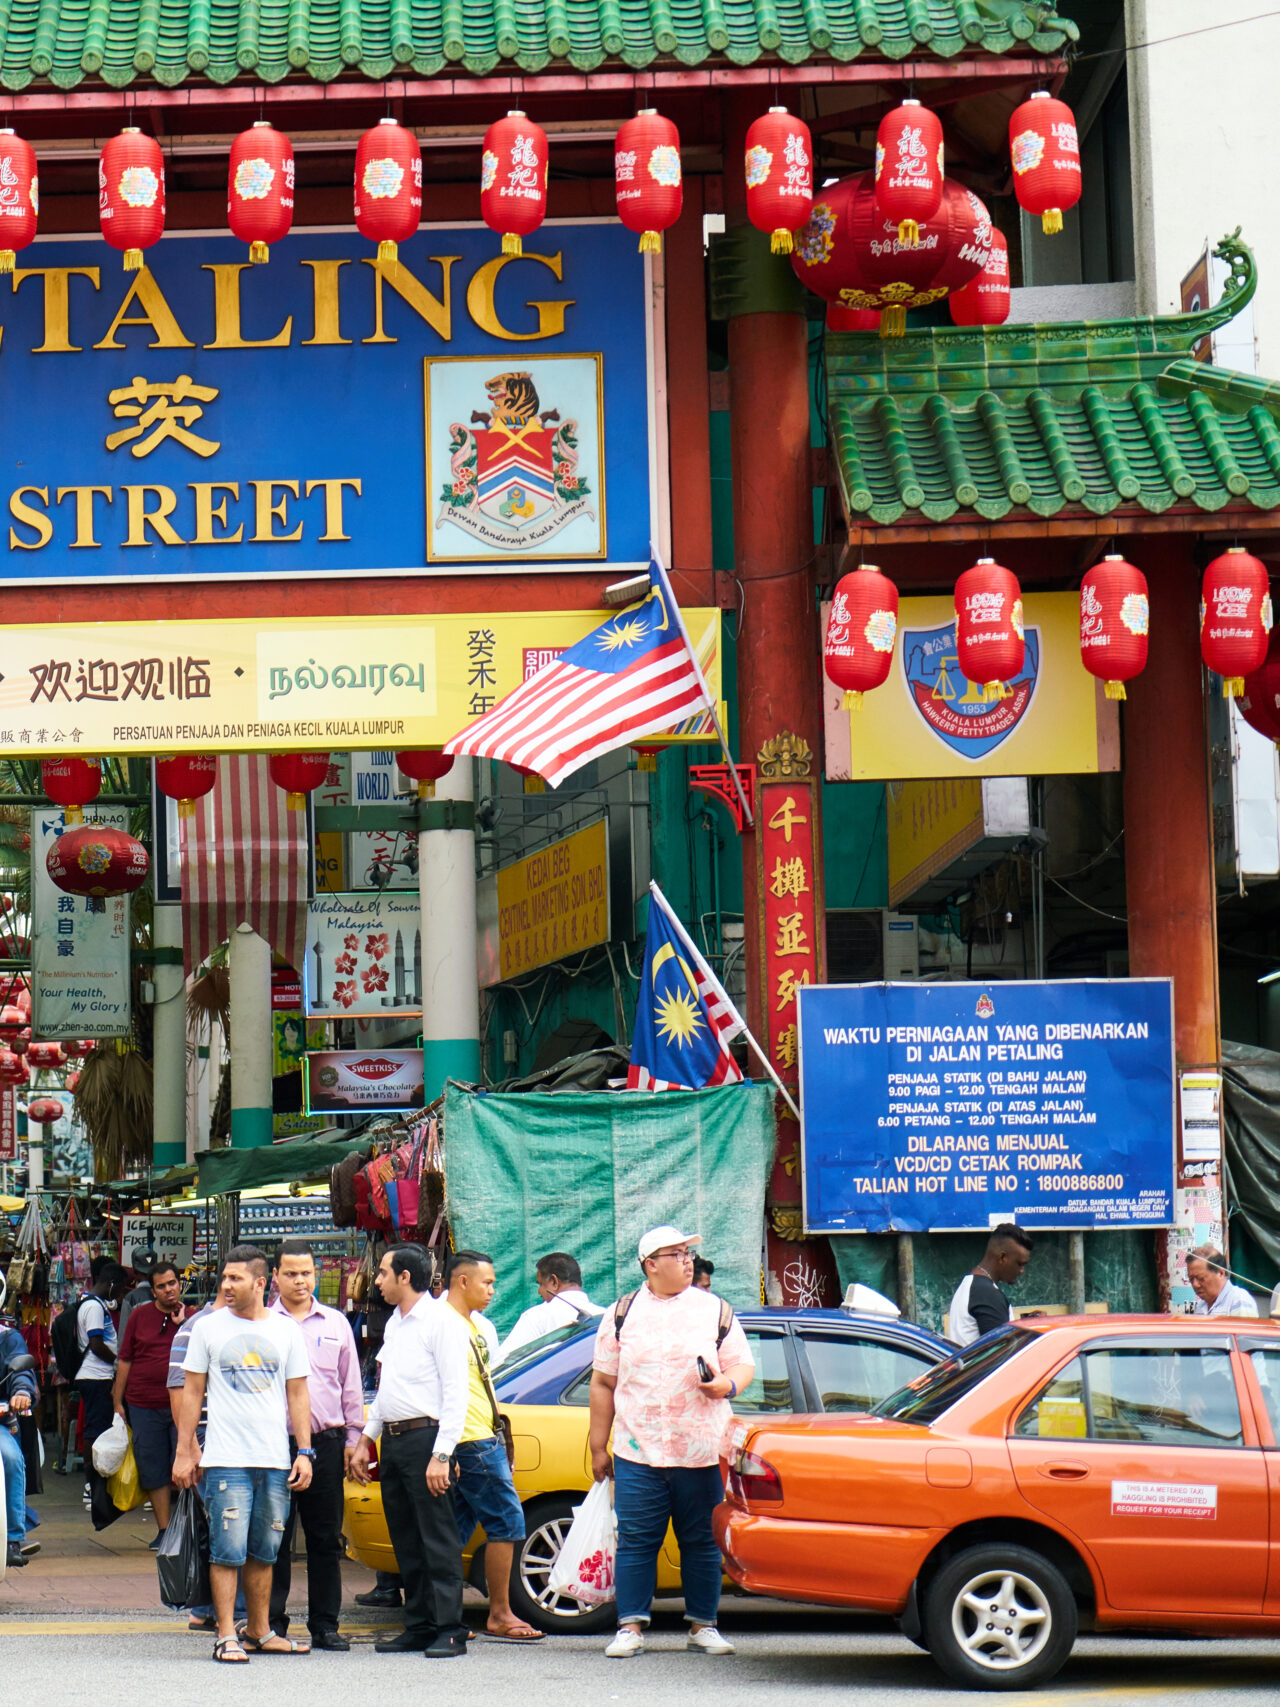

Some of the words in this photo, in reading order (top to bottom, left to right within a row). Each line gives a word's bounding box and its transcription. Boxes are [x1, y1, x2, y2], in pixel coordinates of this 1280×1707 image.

[8, 478, 364, 549] STREET
[447, 507, 477, 529] Dewan
[479, 526, 527, 545] Bandaraya
[529, 525, 554, 540] Kuala
[554, 501, 586, 525] Lumpur
[29, 656, 211, 703] 欢迎观临
[962, 705, 987, 714] 1953
[942, 708, 970, 726] KUALA
[973, 707, 1008, 727] LUMPUR
[113, 726, 173, 741] PERSATUAN
[175, 724, 221, 740] PENJAJA
[223, 724, 244, 738] DAN
[247, 723, 291, 738] PENIAGA
[293, 722, 323, 737] KECIL
[325, 721, 361, 736] KUALA
[362, 720, 405, 735] LUMPUR
[957, 726, 983, 736] PETTY
[357, 772, 390, 801] WORLD
[310, 900, 365, 914] Wholesale
[327, 916, 384, 934] Malaysia
[39, 988, 63, 998] Your
[66, 988, 107, 1000] Health,
[71, 1002, 88, 1013] My
[90, 1002, 120, 1013] Glory
[823, 1027, 881, 1045] WAKTU
[886, 1025, 988, 1043] PERNIAGAAN
[995, 1024, 1039, 1041] YANG
[1045, 1022, 1149, 1040] DIBENARKAN
[906, 1046, 923, 1062] DI
[928, 1045, 981, 1062] JALAN
[987, 1044, 1064, 1061] PETALING
[351, 1064, 398, 1073] SWEETKISS
[887, 1072, 939, 1084] PENJAJA
[943, 1072, 982, 1083] STATIK
[986, 1071, 1003, 1084] (DI
[1007, 1071, 1040, 1083] BAHU
[1043, 1070, 1088, 1083] JALAN)
[377, 1082, 416, 1091] Chocolate
[888, 1085, 911, 1097] 9.00
[915, 1085, 941, 1097] PAGI
[957, 1084, 985, 1096] 12.00
[989, 1083, 1038, 1095] TENGAH
[1041, 1082, 1086, 1094] MALAM
[888, 1102, 939, 1114] PENJAJA
[943, 1101, 982, 1113] STATIK
[986, 1101, 1003, 1114] (DI
[1007, 1100, 1036, 1112] ATAS
[1041, 1100, 1084, 1113] JALAN)
[877, 1115, 900, 1127] 6.00
[904, 1115, 951, 1126] PETANG
[967, 1114, 995, 1126] 12.00
[1000, 1113, 1049, 1125] TENGAH
[1053, 1112, 1097, 1124] MALAM
[908, 1135, 990, 1153] DILARANG
[996, 1133, 1069, 1151] MENJUAL
[894, 1156, 952, 1173] VCD/CD
[958, 1155, 1010, 1172] CETAK
[1017, 1153, 1083, 1170] ROMPAK
[853, 1178, 909, 1194] TALIAN
[915, 1177, 947, 1193] HOT
[954, 1176, 988, 1192] LINE
[994, 1175, 1019, 1191] NO
[1036, 1174, 1124, 1190] 1800886800
[1014, 1206, 1058, 1214] KEMENTERIAN
[127, 1220, 146, 1231] ICE
[151, 1222, 185, 1232] WATCH
[160, 1236, 189, 1246] PRICE
[1156, 1486, 1188, 1494] METERED
[1121, 1494, 1157, 1502] HAGGLING
[1166, 1496, 1208, 1504] PROHIBITED
[1116, 1504, 1148, 1513] REQUEST
[1183, 1508, 1212, 1516] RECEIPT
